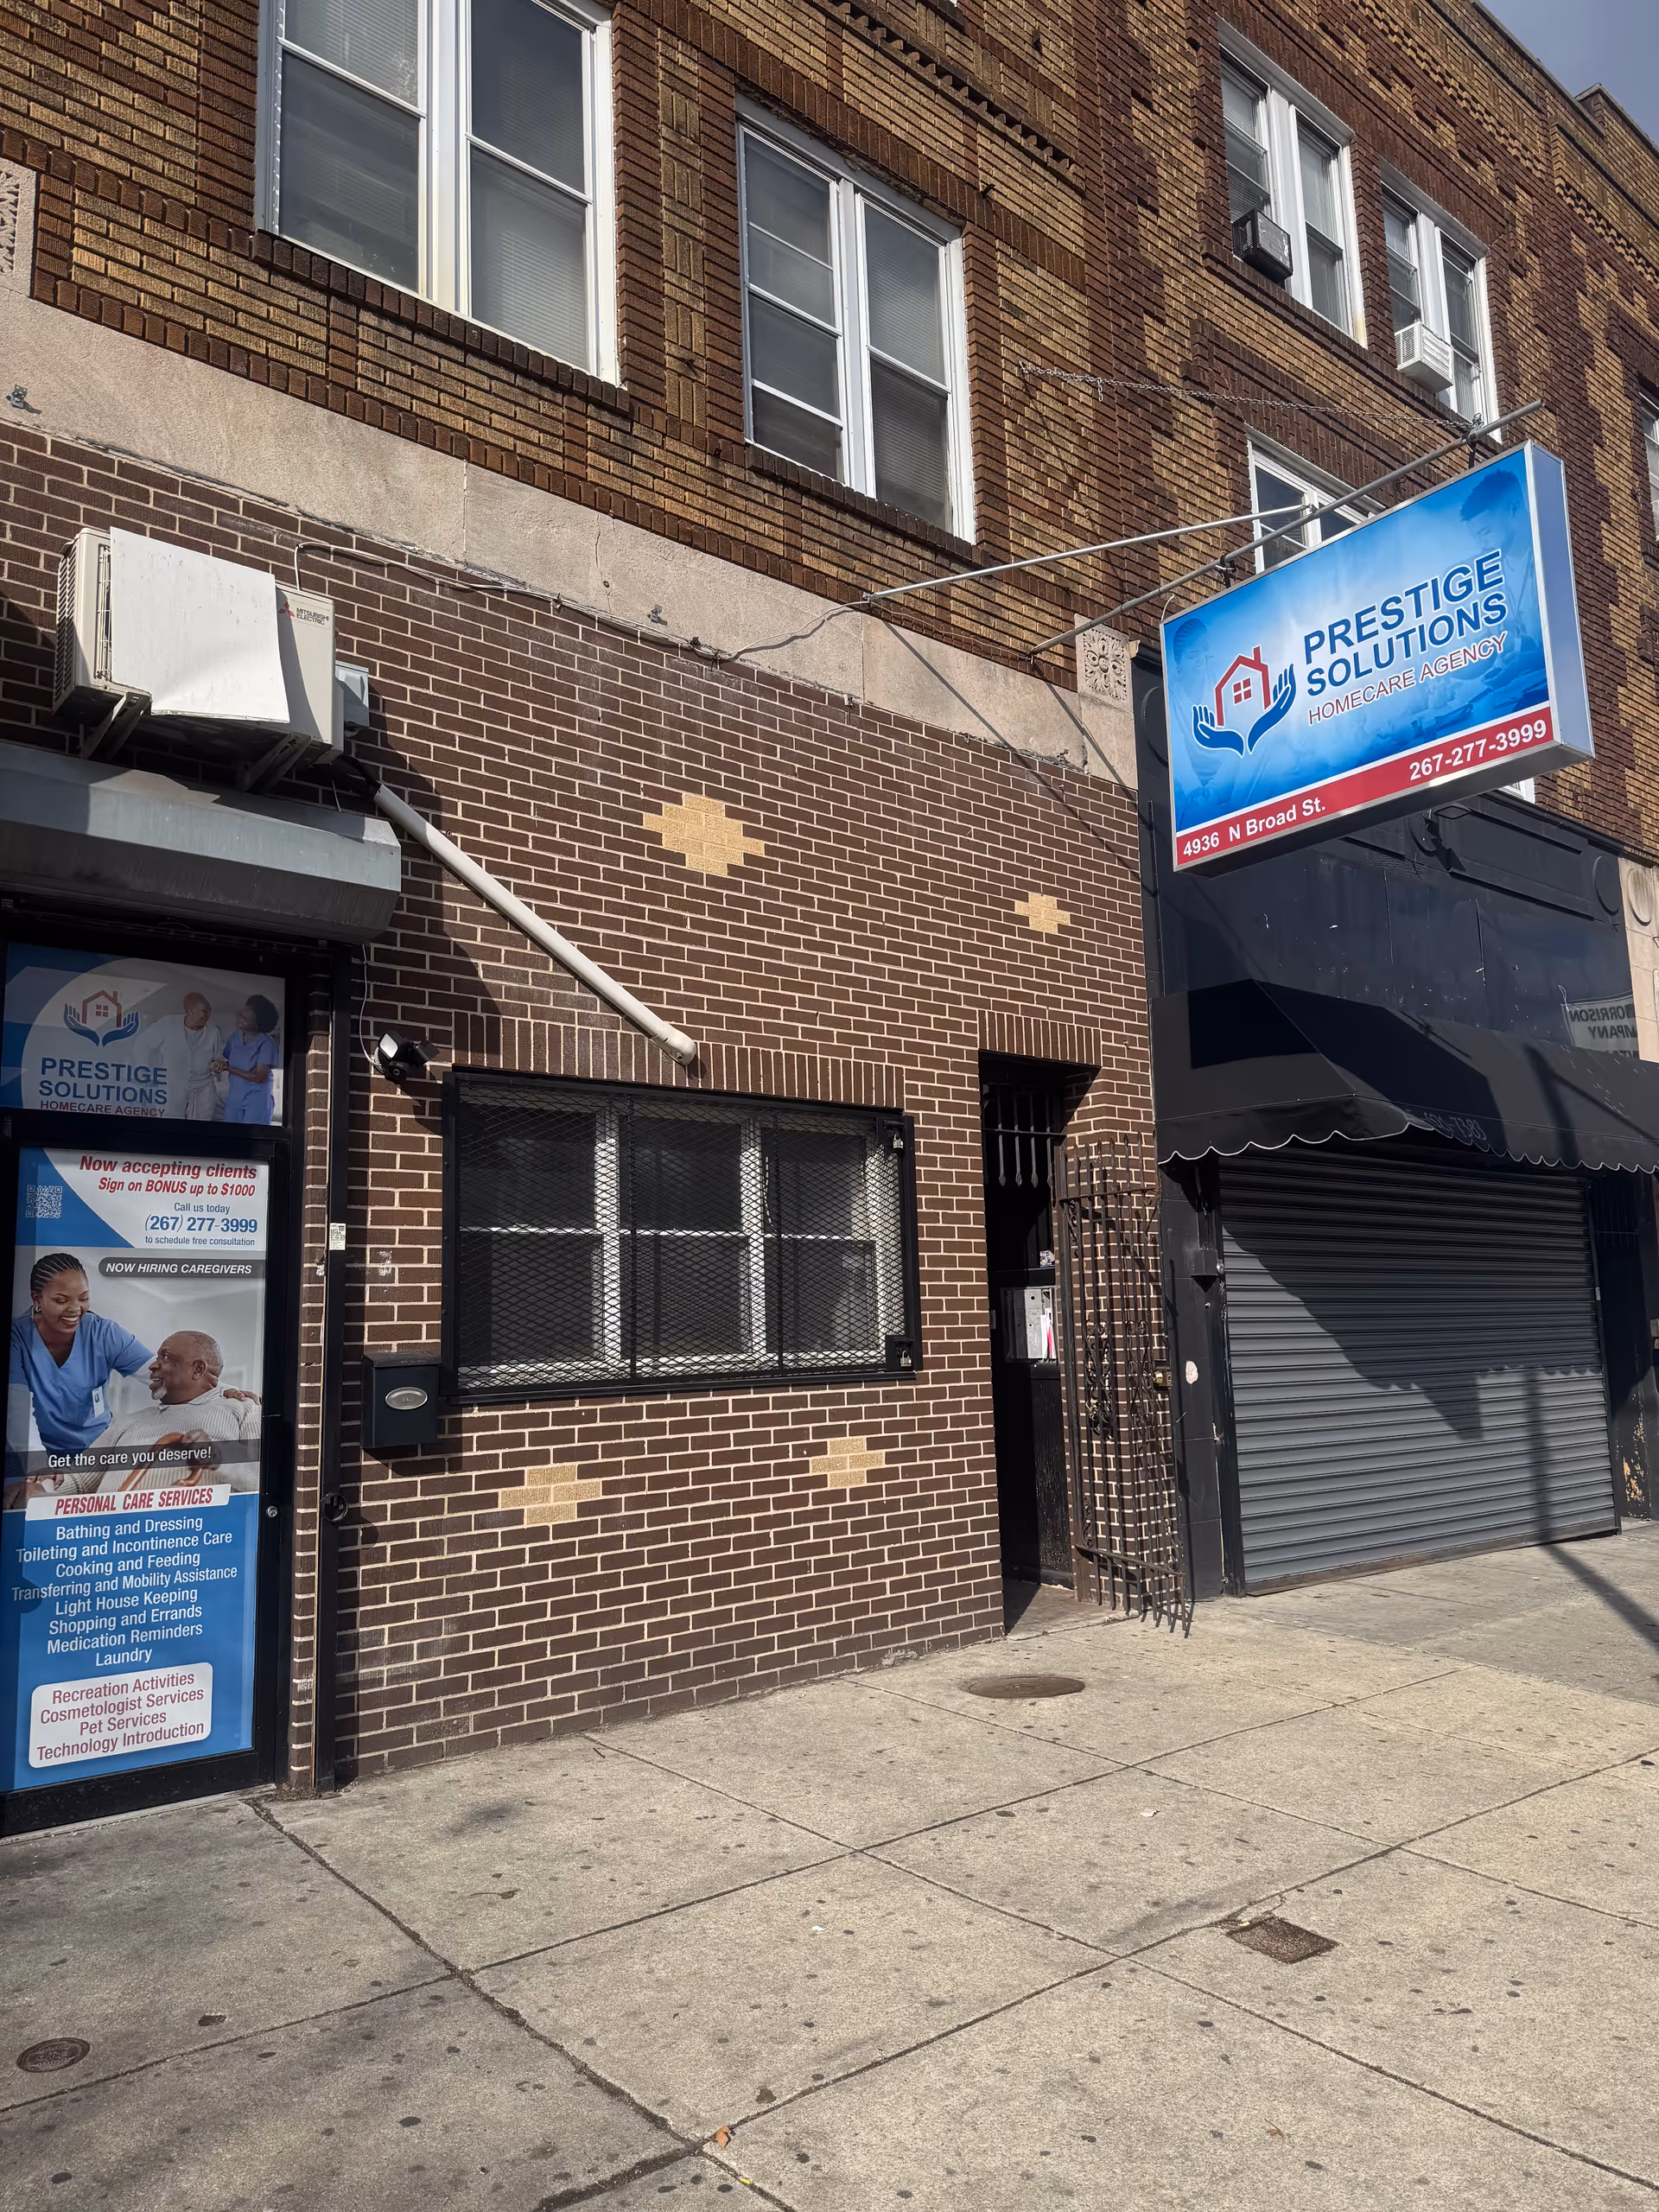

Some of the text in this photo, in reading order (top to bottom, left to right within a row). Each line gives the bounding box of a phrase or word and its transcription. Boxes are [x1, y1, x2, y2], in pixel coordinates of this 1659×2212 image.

[296, 608, 328, 621] MITSUBISHI
[296, 613, 325, 625] ELECTRIC
[1304, 550, 1503, 664] PRESTIGE
[1307, 593, 1506, 696] SOLUTIONS
[1309, 633, 1506, 724] HOMECARE AGENCY
[1409, 719, 1546, 780] 267-277-3999
[1183, 797, 1325, 856] 4936 N Broad St.
[41, 1058, 167, 1084] PRESTIGE
[39, 1080, 167, 1104] SOLUTIONS
[41, 1100, 166, 1116] HOMECARE AGENCY
[79, 1155, 257, 1179] Now accepting clients
[99, 1178, 255, 1197] Sign on BONUS up to $1000
[174, 1202, 191, 1212] Call
[207, 1203, 230, 1214] today
[145, 1214, 257, 1233] (267) 277-3999
[145, 1236, 255, 1246] to schedule free consultation
[105, 1262, 252, 1274] NOW HIRING CAREGIVERS
[48, 1446, 211, 1468] Get the care you deserve!
[54, 1487, 213, 1515] PERSONAL CARE SERVICES
[56, 1516, 203, 1541] Bathing and Dressing
[16, 1531, 232, 1563] Toileting and Incontinence Care
[55, 1552, 200, 1578] Cooking and Feeding
[12, 1565, 238, 1601] Transferring and Mobility Assistance
[55, 1587, 198, 1616] Light House Keeping
[49, 1605, 202, 1635] Shopping and Errands
[47, 1622, 203, 1654] Medication Reminders
[96, 1647, 153, 1667] Laundry
[53, 1673, 195, 1705] Recreation Activities
[41, 1688, 204, 1725] Cosmetologist Services
[79, 1711, 167, 1736] Pet Services
[37, 1721, 204, 1761] Technology Introduction
